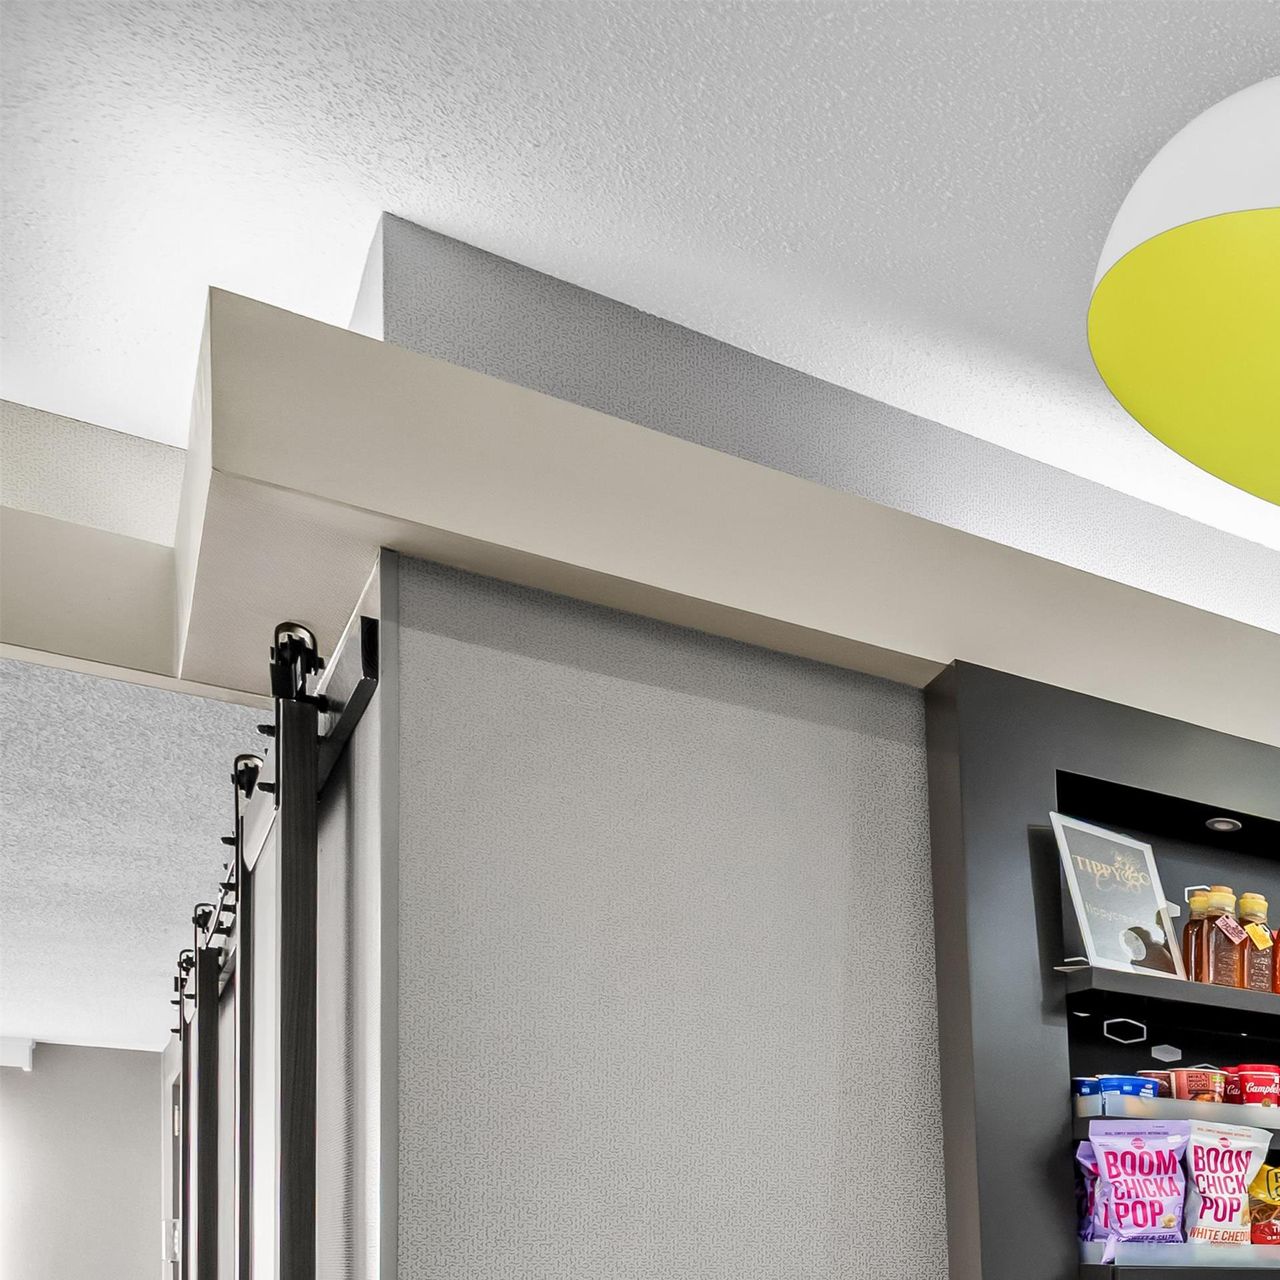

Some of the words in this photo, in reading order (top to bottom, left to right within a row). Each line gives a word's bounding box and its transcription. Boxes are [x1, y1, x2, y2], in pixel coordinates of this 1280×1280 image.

[1104, 1150, 1177, 1179] BOOM
[1112, 1176, 1180, 1201] CHICKA
[1195, 1173, 1249, 1195] CHICK
[1115, 1200, 1164, 1229] POP
[1199, 1196, 1241, 1223] POP
[1190, 1227, 1219, 1241] WHITE
